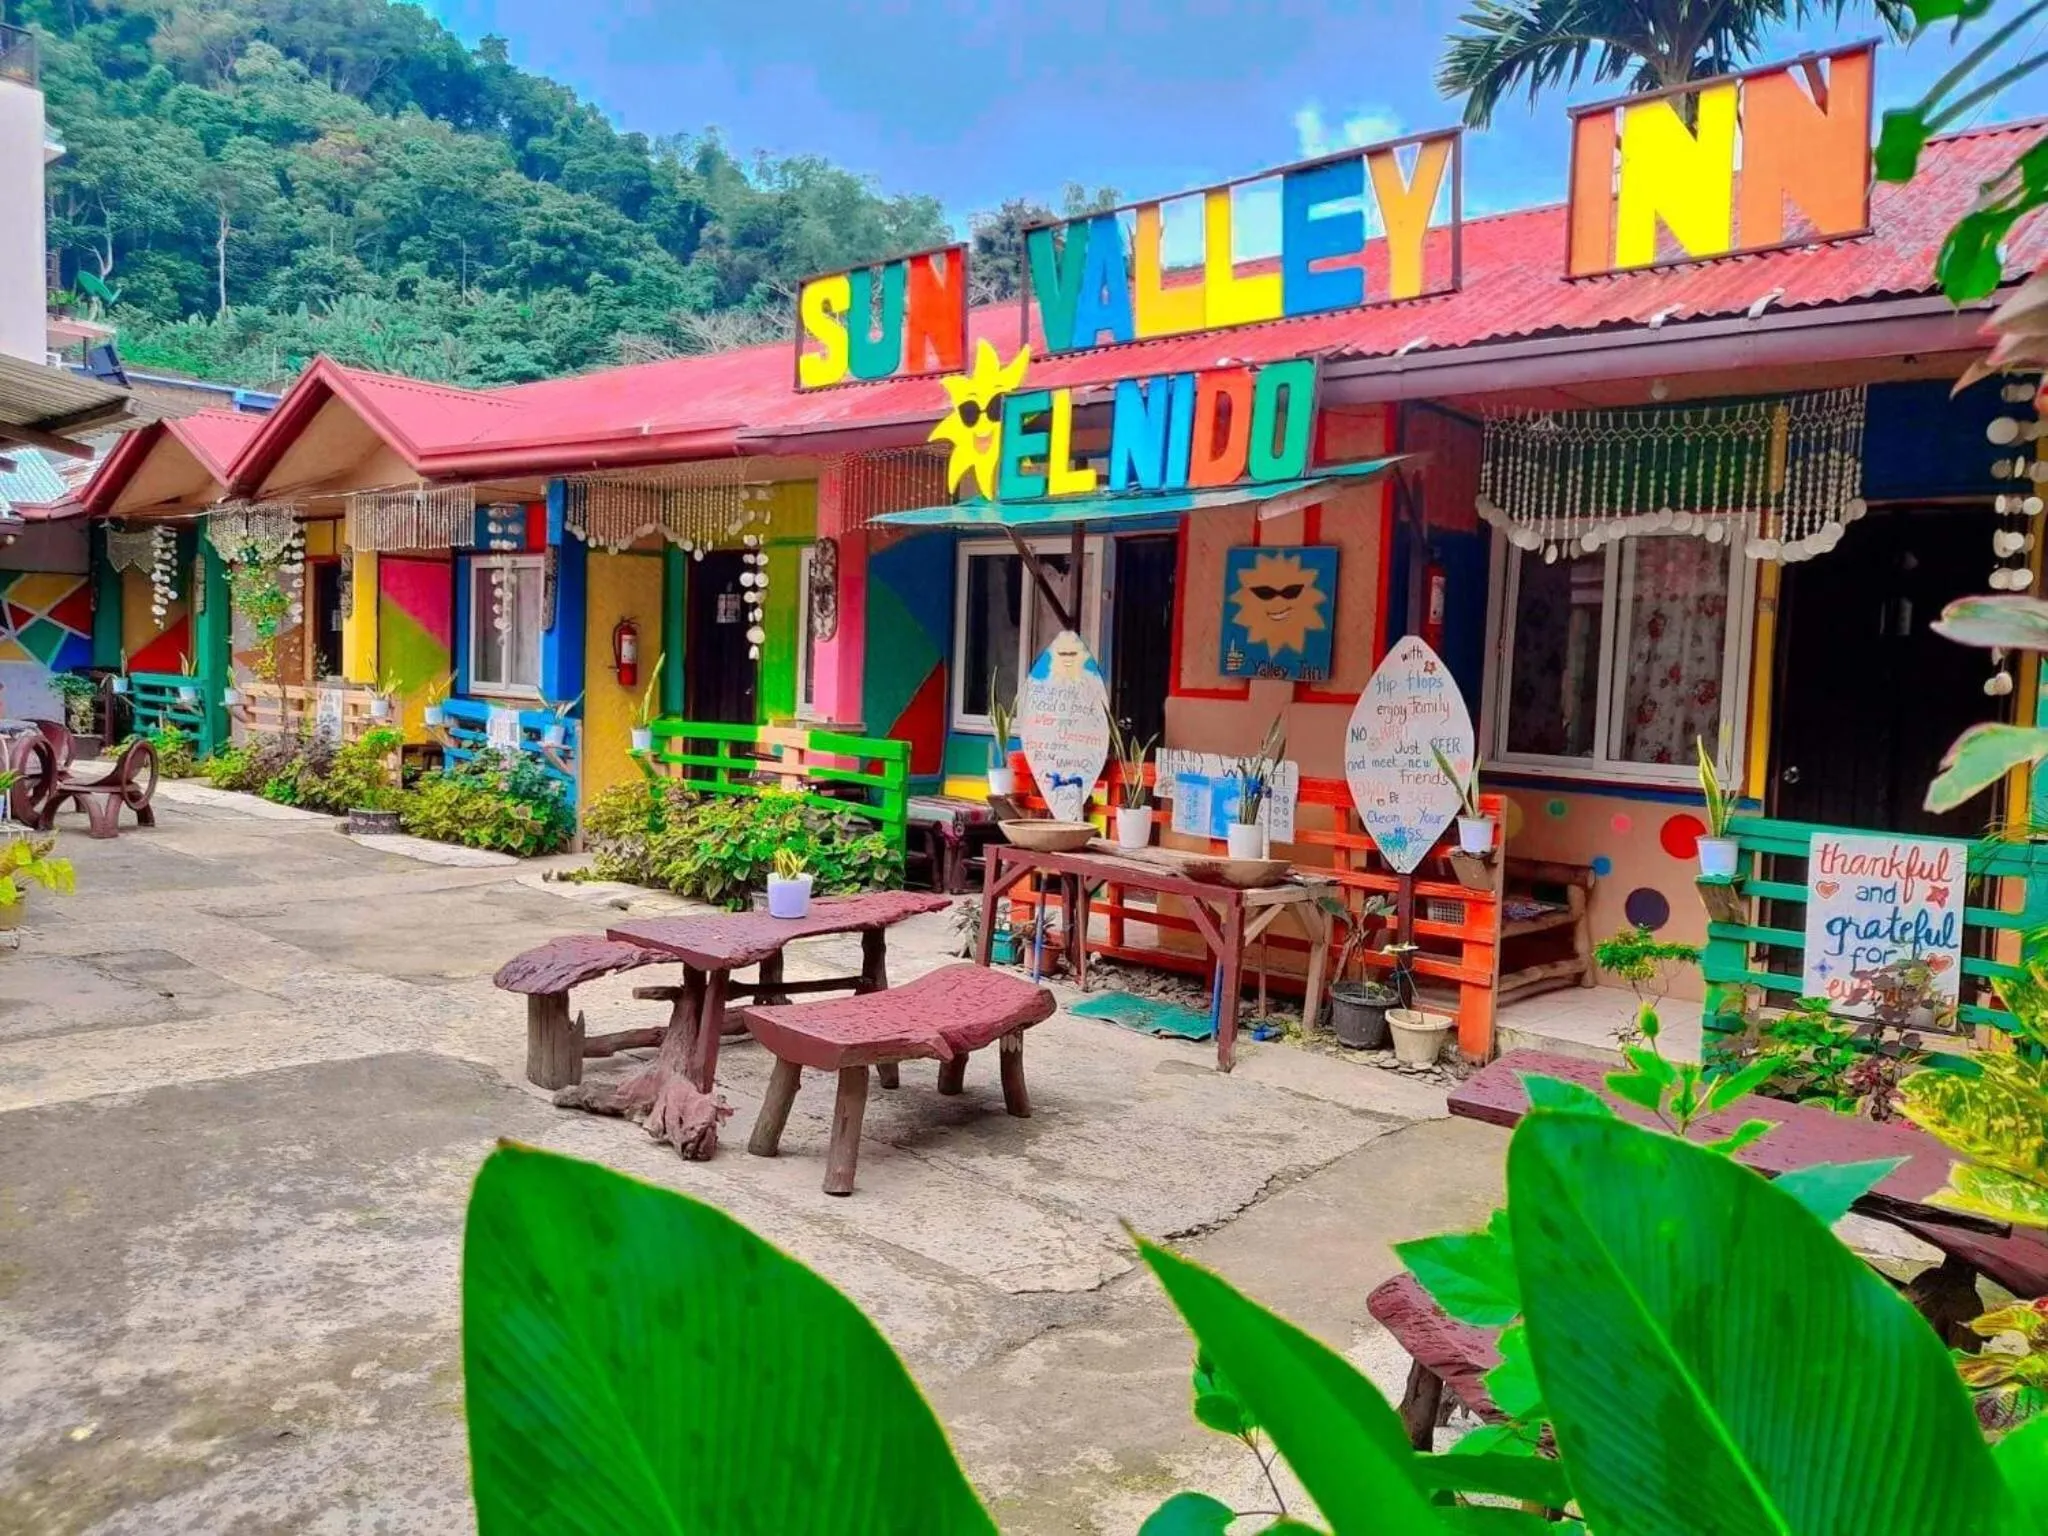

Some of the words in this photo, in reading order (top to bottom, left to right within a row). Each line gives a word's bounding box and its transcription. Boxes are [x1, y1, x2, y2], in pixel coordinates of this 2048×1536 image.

[799, 247, 964, 389] SUN
[1027, 137, 1453, 354] VALLEY
[1569, 50, 1873, 276] INN
[1000, 387, 1097, 501] EL
[1109, 357, 1316, 493] NIDO
[1400, 644, 1423, 662] with
[1351, 726, 1368, 743] NO
[1394, 739, 1422, 755] Just
[1816, 842, 1952, 903] thankful
[1855, 881, 1898, 904] and
[1824, 906, 1958, 958] grateful
[1850, 945, 1898, 971] for
